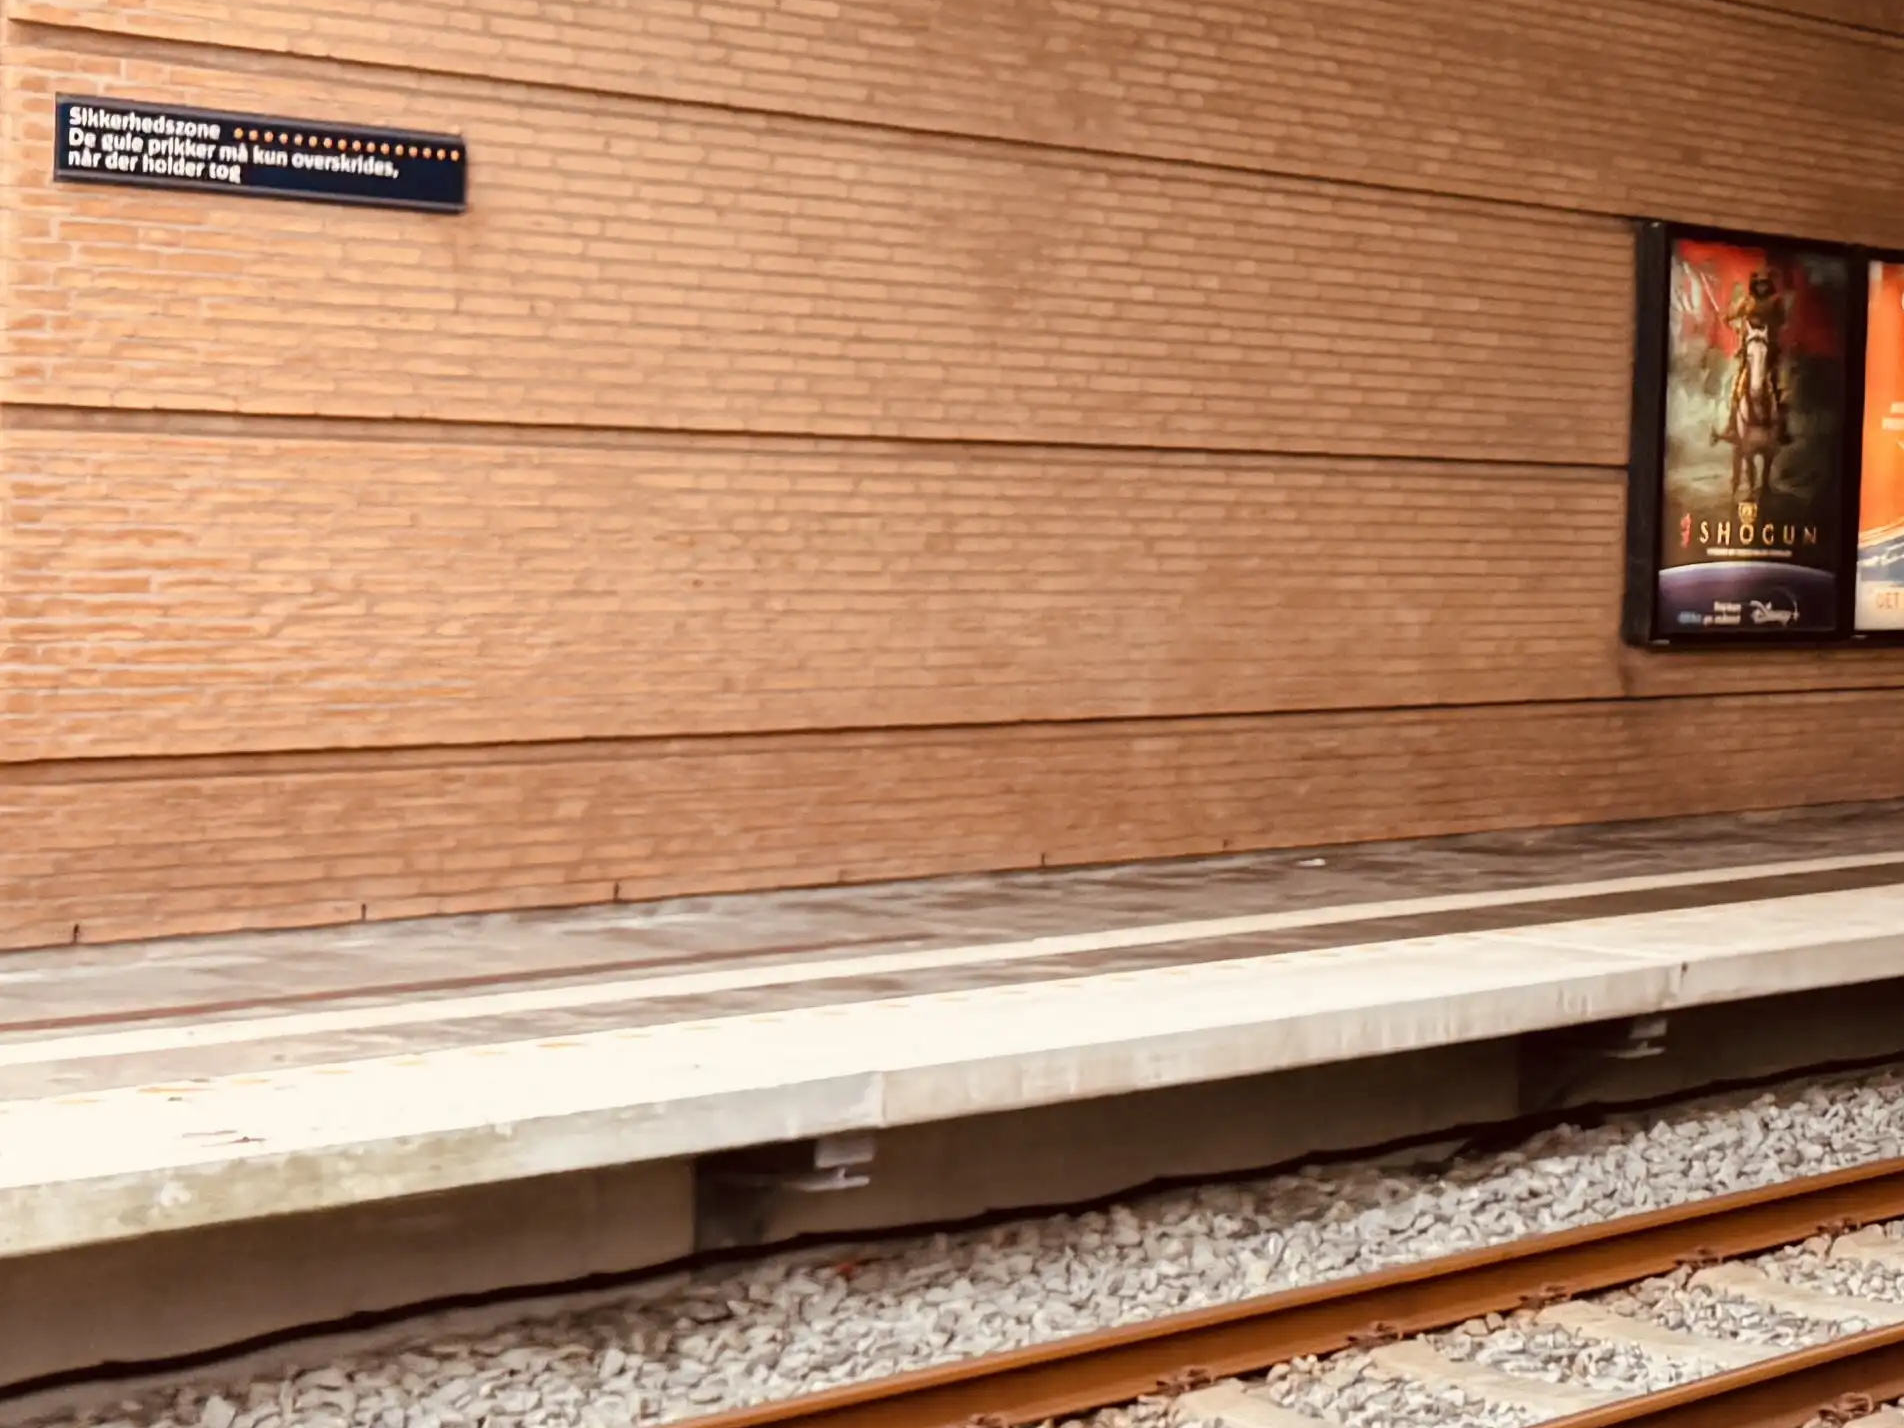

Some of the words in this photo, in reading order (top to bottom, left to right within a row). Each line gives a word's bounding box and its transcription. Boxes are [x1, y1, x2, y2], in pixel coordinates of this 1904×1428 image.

[69, 105, 221, 140] Sikkerhedszone
[68, 127, 96, 148] De
[101, 131, 144, 152] gule
[148, 136, 217, 159] prikker
[219, 142, 249, 164] må
[252, 145, 288, 167] kun
[291, 153, 400, 180] overskrides,
[68, 147, 102, 168] når
[105, 151, 139, 172] der
[142, 154, 206, 177] holder
[209, 161, 241, 183] tog
[1699, 520, 1818, 546] SHOGUN
